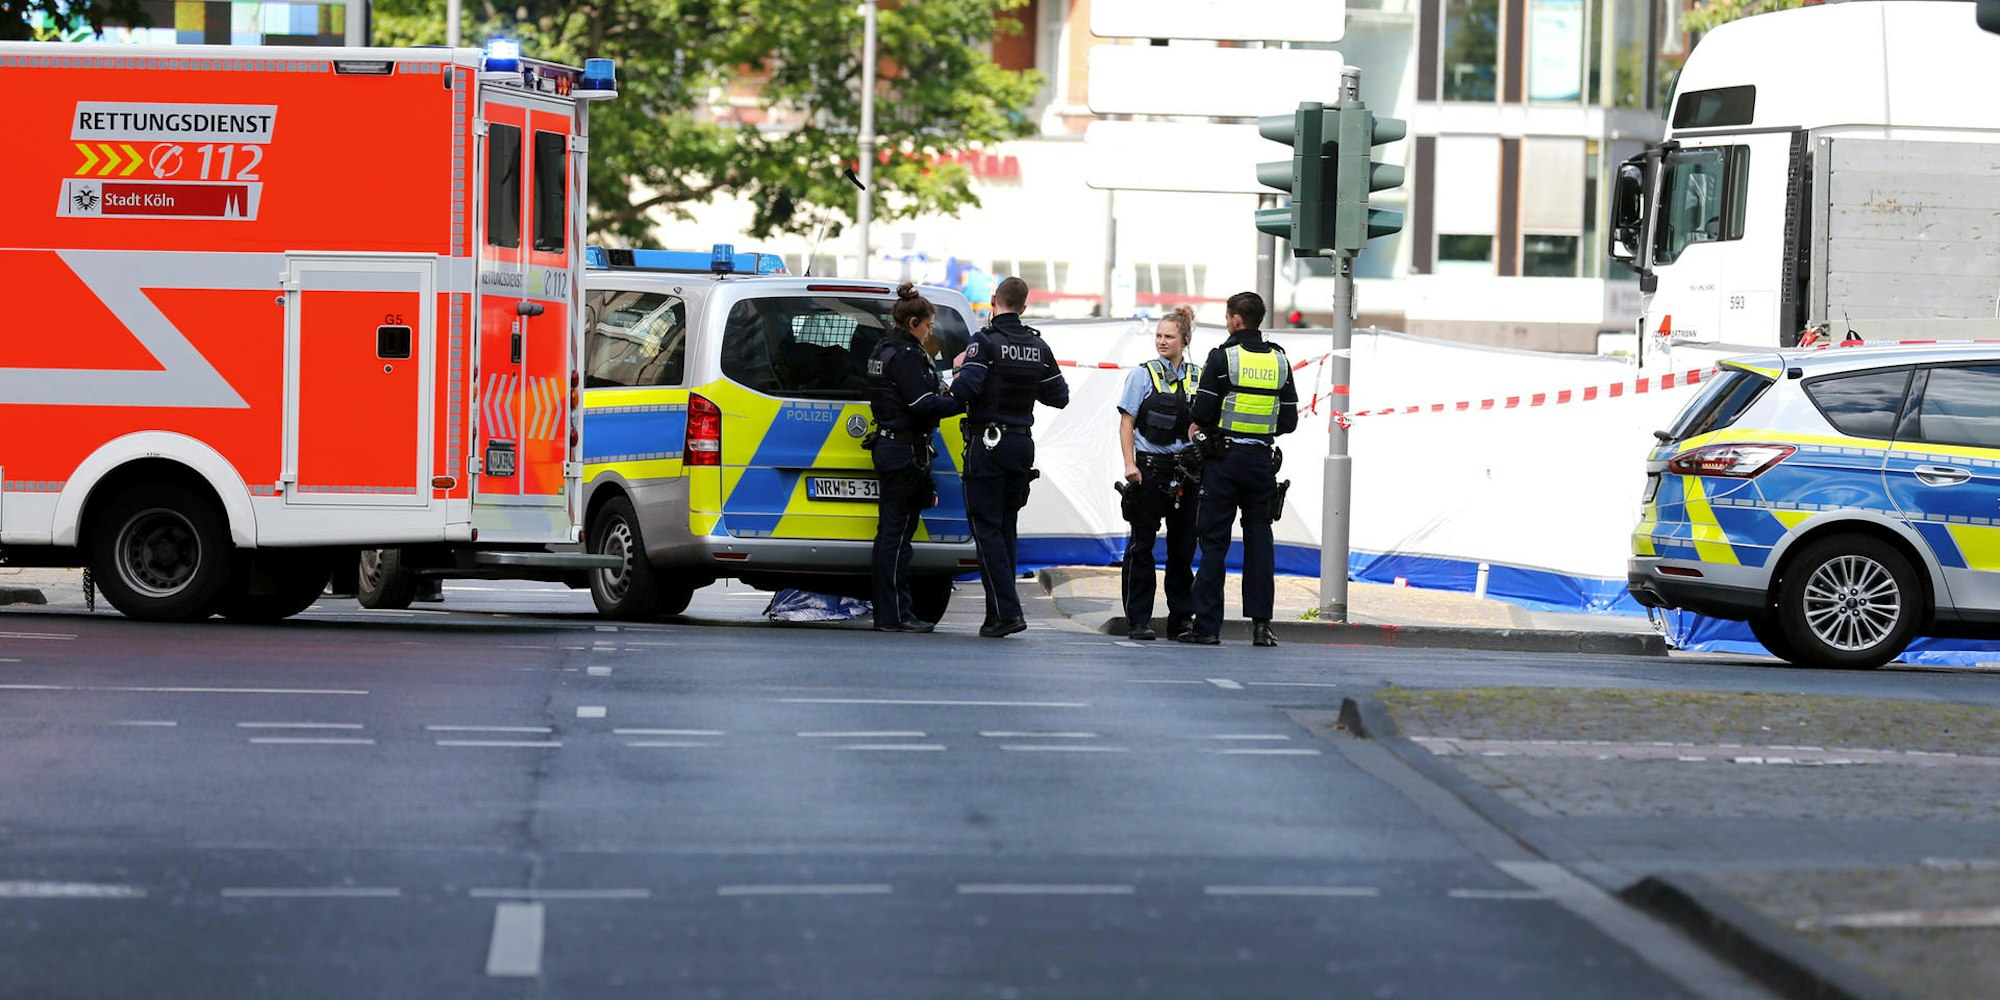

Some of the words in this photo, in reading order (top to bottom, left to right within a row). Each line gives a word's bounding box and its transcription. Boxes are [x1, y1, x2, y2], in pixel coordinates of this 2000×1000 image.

[79, 112, 271, 133] RETTUNGSDIENST
[197, 143, 264, 181] 112
[104, 193, 141, 207] Stadt
[144, 193, 175, 207] Köln
[553, 271, 567, 298] 112
[1729, 296, 1745, 310] 593
[385, 313, 403, 325] G5
[1001, 345, 1041, 362] POLIZEI
[1242, 367, 1276, 381] POLIZEI
[787, 410, 833, 422] POLIZEI
[816, 480, 840, 495] NRW
